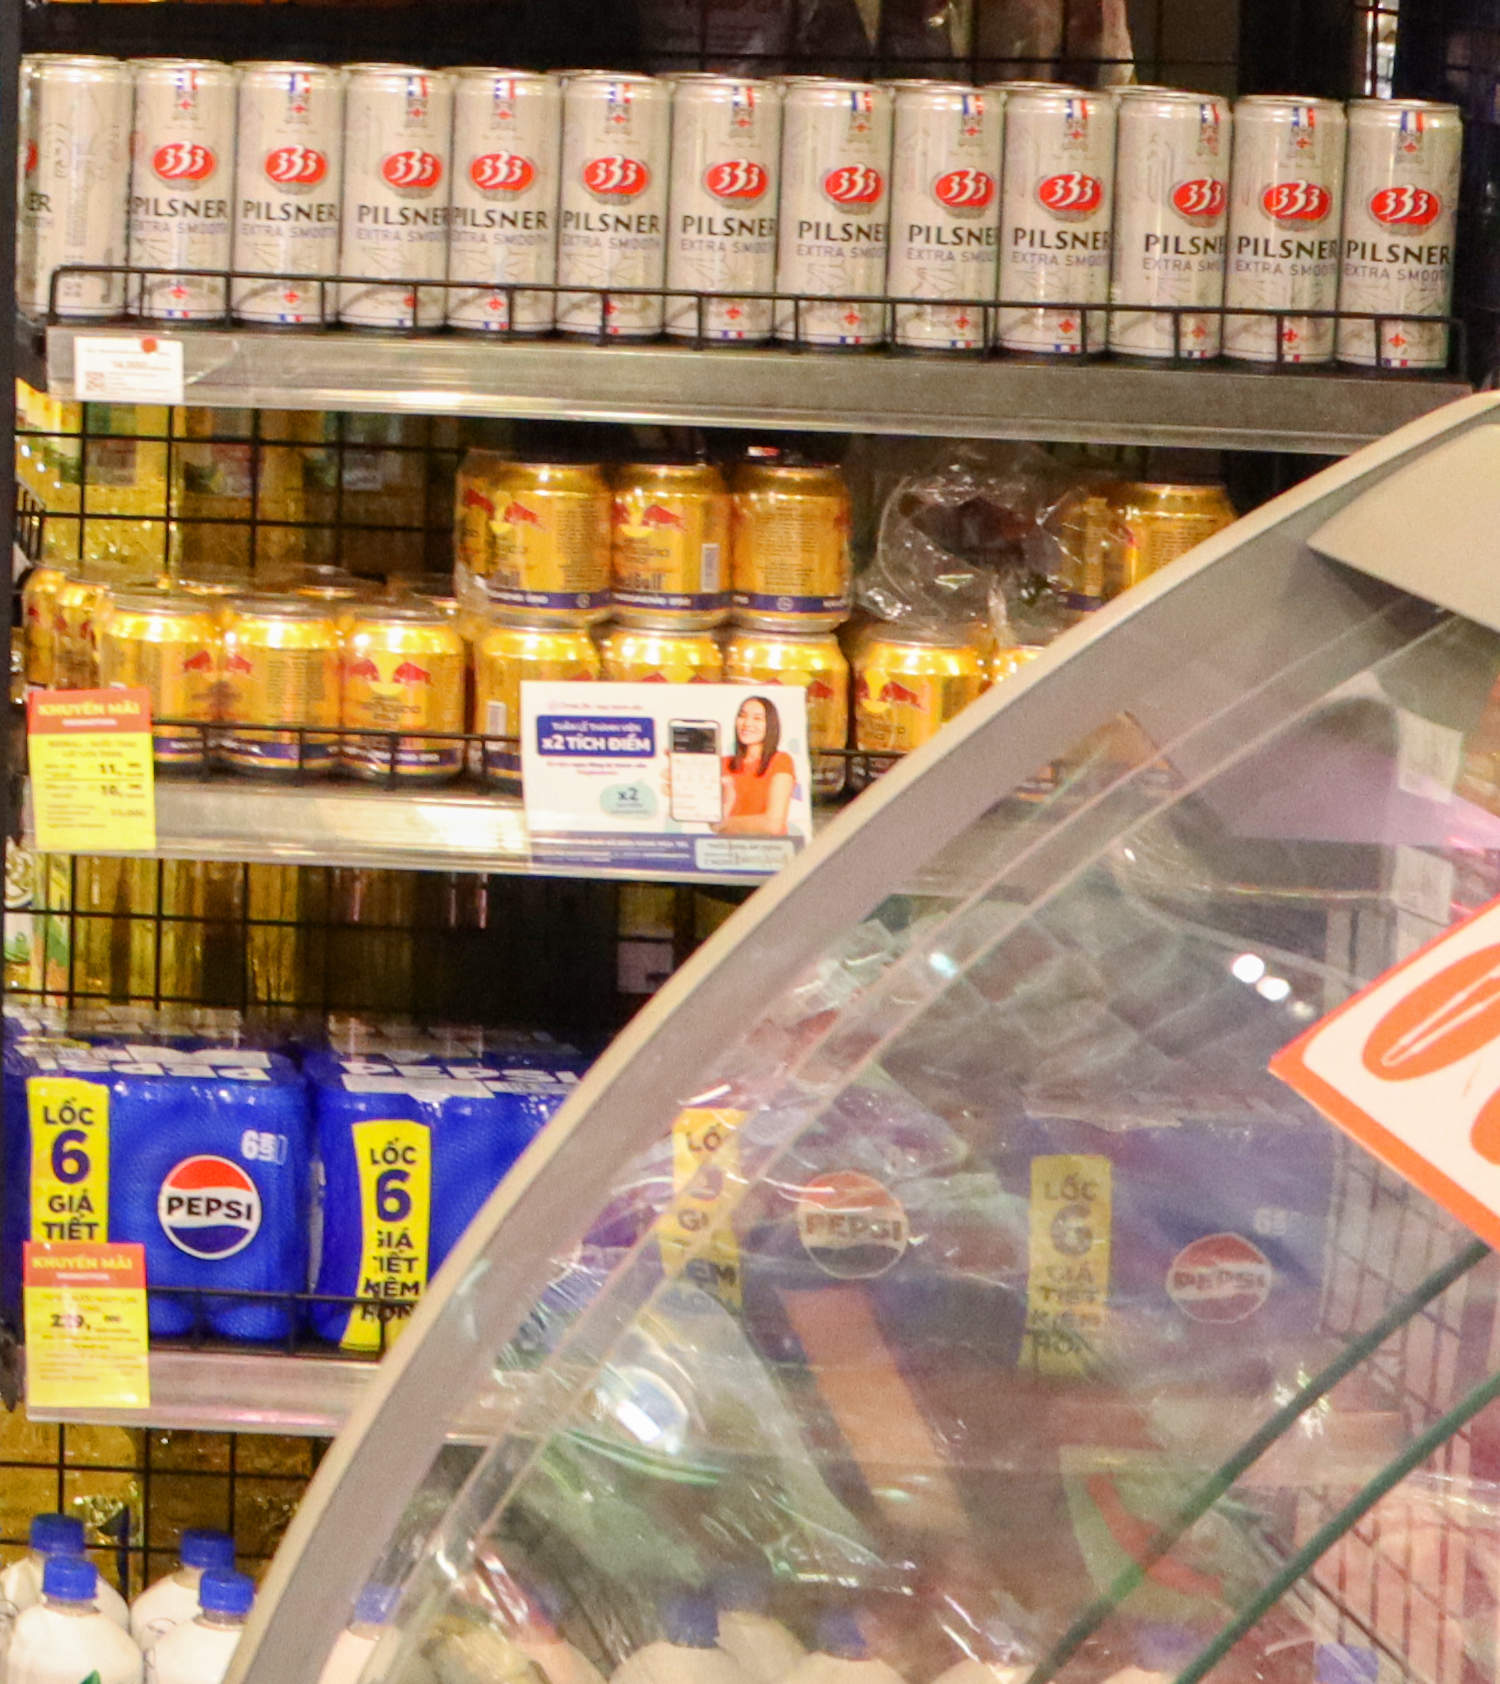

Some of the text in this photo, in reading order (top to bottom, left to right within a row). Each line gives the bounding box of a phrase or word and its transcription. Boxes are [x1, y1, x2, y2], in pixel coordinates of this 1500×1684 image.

[164, 141, 204, 178] 333
[276, 145, 316, 179] 333
[393, 148, 434, 182] 333
[481, 151, 522, 185] 333
[596, 150, 637, 188] 333
[719, 158, 759, 194] 333
[837, 163, 877, 199] 333
[949, 167, 988, 204] 333
[1052, 171, 1095, 208] 333
[1184, 177, 1224, 214] 333
[133, 199, 227, 219] PILSNER
[243, 201, 338, 222] PILSNER
[1276, 180, 1320, 219] 333
[1384, 183, 1430, 221] 333
[453, 205, 548, 229] PILSNER
[563, 210, 661, 234] PILSNER
[1237, 237, 1337, 261] PILSNER
[1346, 239, 1450, 265] PILSNER
[542, 736, 565, 750] x2
[567, 734, 606, 750] TÍCH
[618, 788, 638, 801] x2
[43, 1096, 94, 1126] LỐC
[51, 1130, 90, 1184] 6
[369, 1137, 417, 1166] LỐC
[49, 1193, 94, 1214] GIÁ
[166, 1195, 253, 1222] PEPSI
[376, 1169, 411, 1222] 6
[42, 1209, 99, 1241] TIẾT
